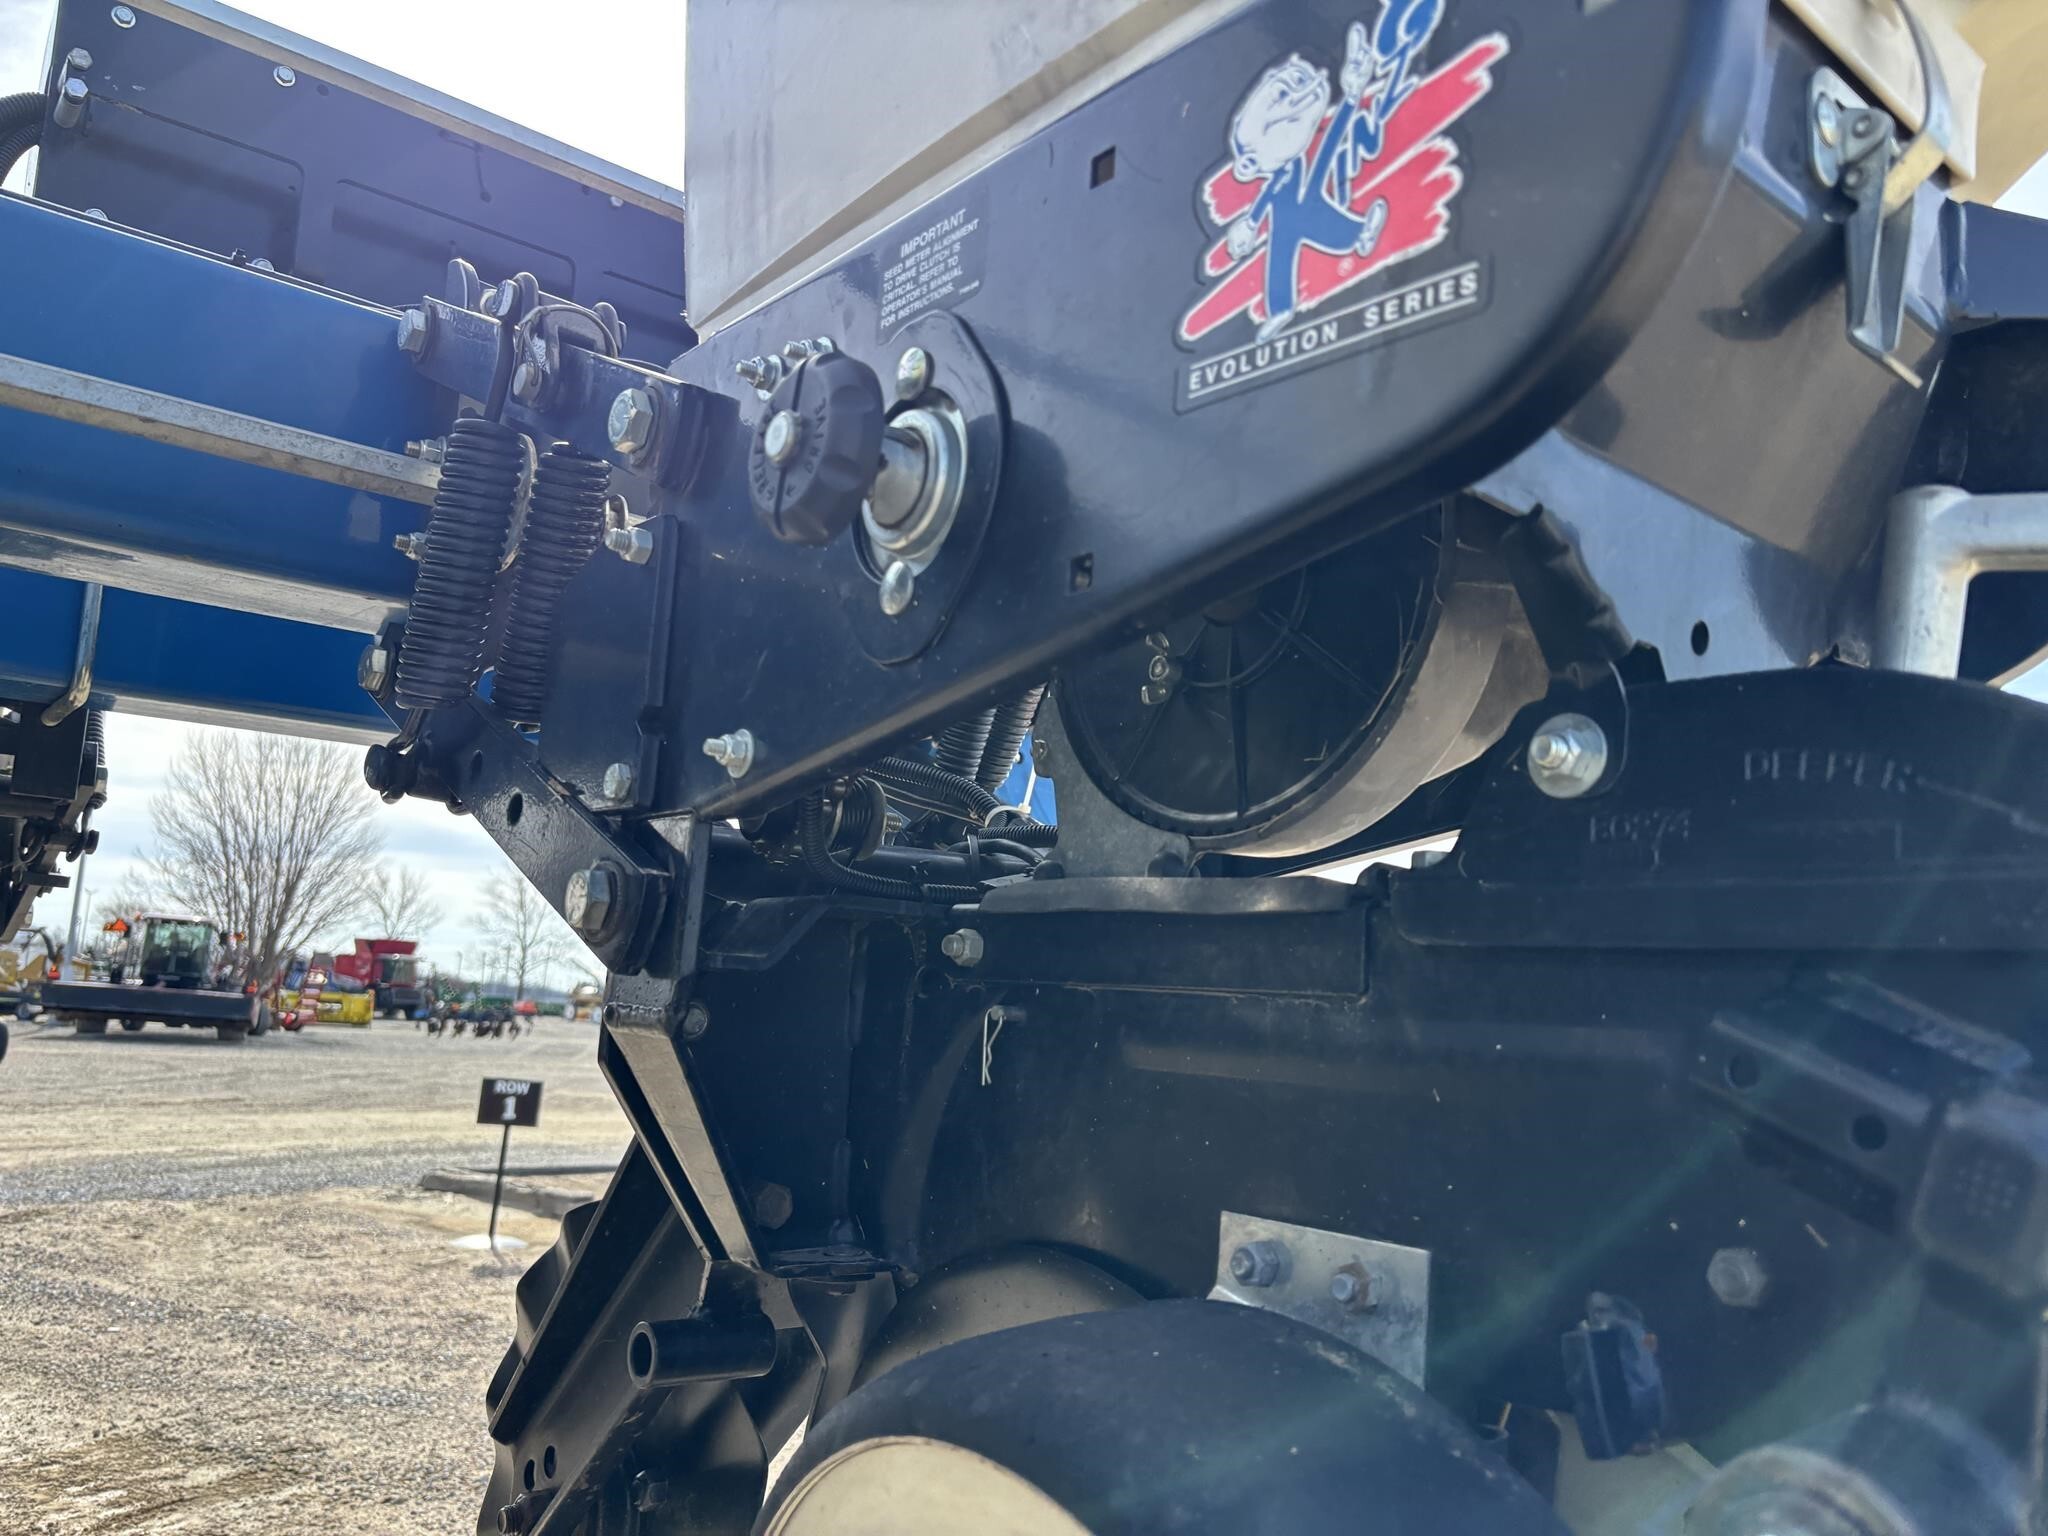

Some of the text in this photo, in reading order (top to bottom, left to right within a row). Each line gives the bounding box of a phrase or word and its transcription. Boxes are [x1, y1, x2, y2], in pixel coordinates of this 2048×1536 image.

[900, 208, 966, 258] IMPORTANT
[884, 218, 980, 281] SEED METER ALIGNMENT
[947, 255, 959, 268] TO
[883, 241, 961, 292] TO DRIVE CLUTCH IS
[930, 265, 964, 290] MANUAL
[880, 313, 896, 329] FOR
[1188, 271, 1479, 391] EVOLUTION SERIES
[494, 1079, 531, 1095] ROW
[501, 1096, 517, 1120] 1
